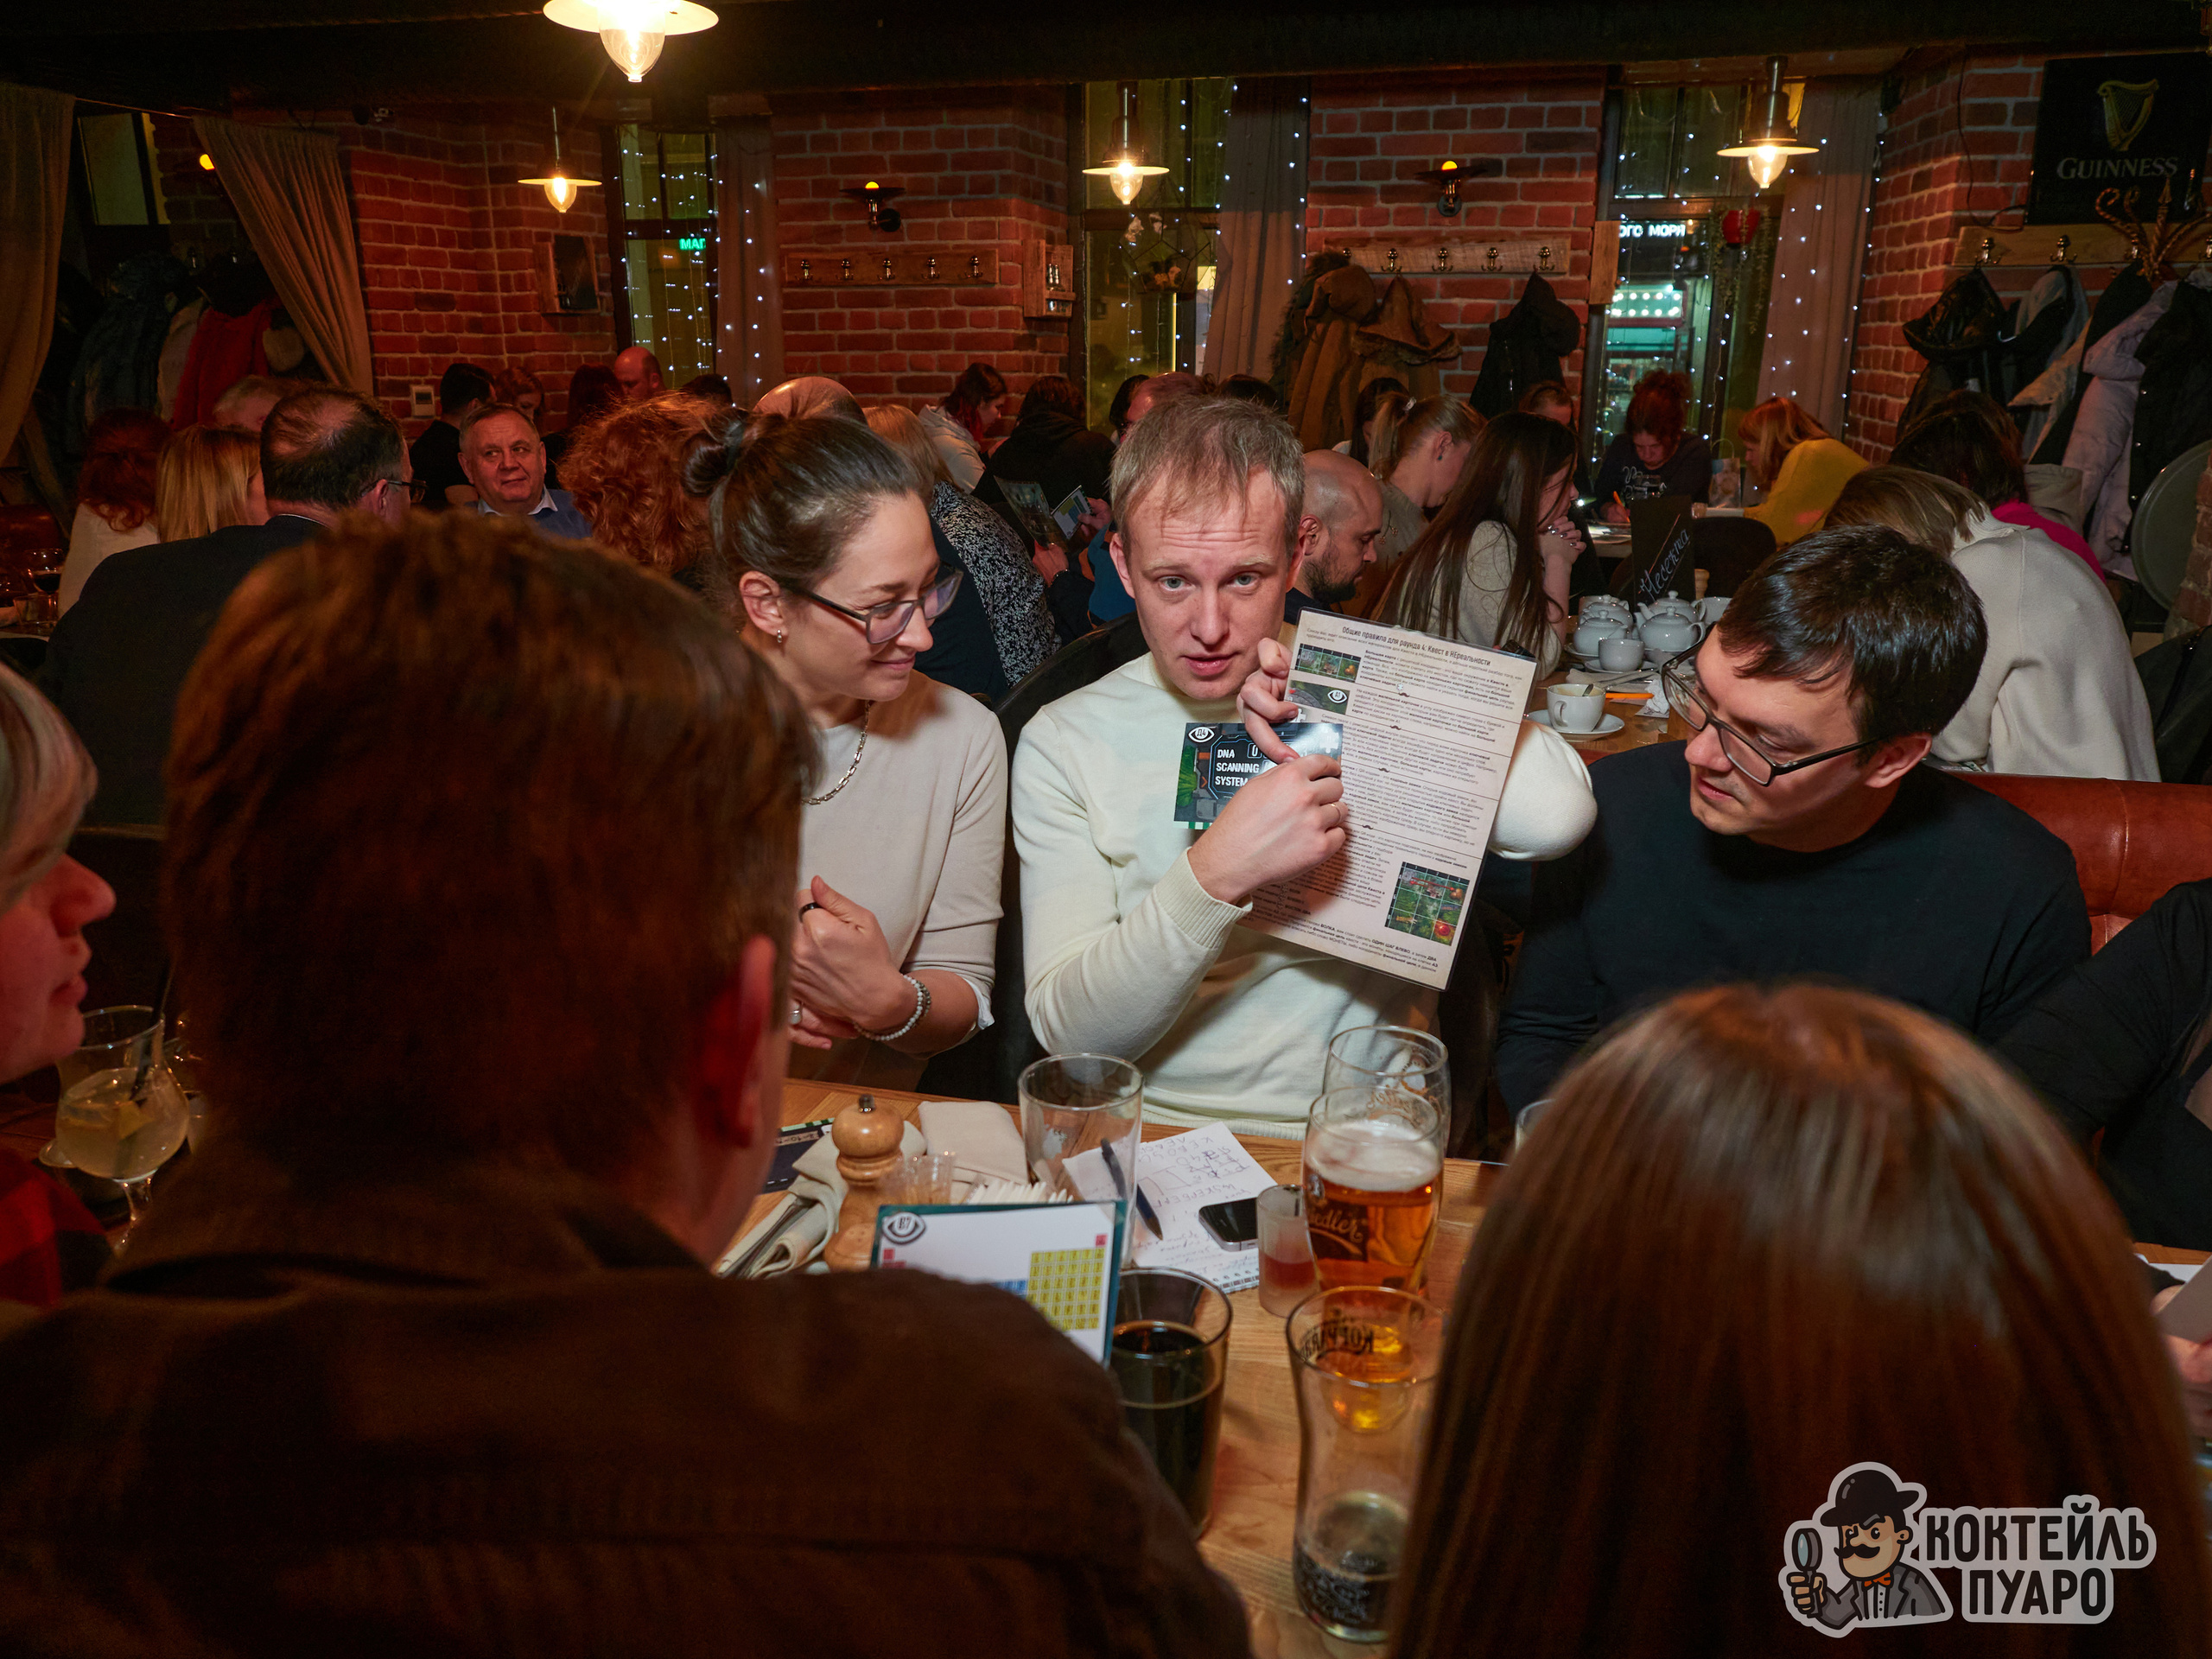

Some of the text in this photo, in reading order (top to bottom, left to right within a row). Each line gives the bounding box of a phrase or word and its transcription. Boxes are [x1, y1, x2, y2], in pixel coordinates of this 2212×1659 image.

[2056, 157, 2178, 180] GUINNESS
[679, 238, 706, 251] МАГ
[1342, 626, 1361, 636] Общие
[1362, 632, 1386, 642] правила
[1399, 640, 1420, 650] раунда
[1427, 645, 1444, 654] Квест
[1449, 651, 1491, 666] НЕреальности
[1217, 749, 1236, 759] DNA
[1216, 762, 1260, 773] SCANNING
[1215, 776, 1249, 787] SYSTEM
